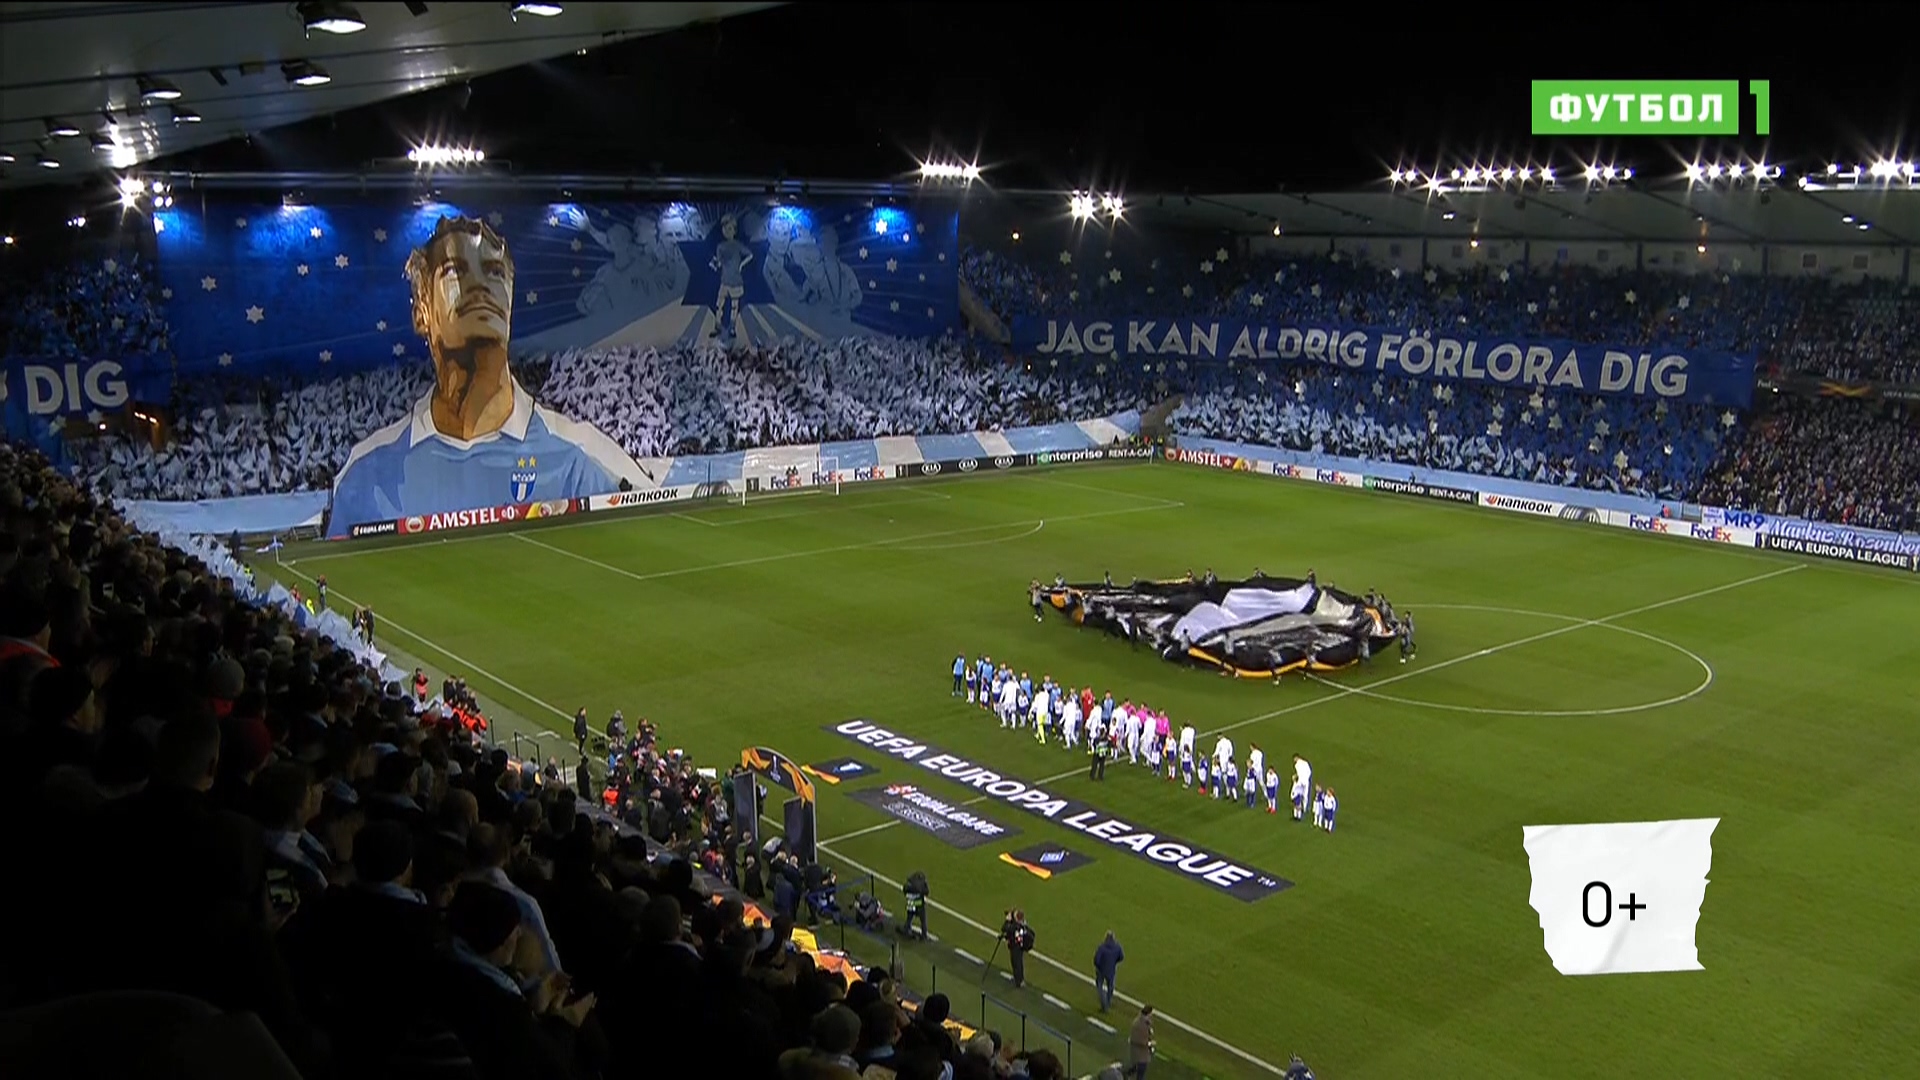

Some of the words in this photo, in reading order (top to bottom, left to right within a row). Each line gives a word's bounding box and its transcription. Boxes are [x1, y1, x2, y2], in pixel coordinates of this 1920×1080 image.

[1036, 320, 1115, 354] JAG
[1127, 321, 1220, 357] KAN
[1228, 325, 1368, 367] ALDRIG
[1375, 328, 1584, 389] FÖRLORA
[1599, 351, 1689, 396] DIG
[24, 360, 129, 414] DIG
[1040, 448, 1104, 463] enterprise
[1178, 450, 1223, 468] AMSTEL
[854, 465, 886, 481] FedEx
[1272, 462, 1301, 478] FedEx
[1316, 468, 1348, 485] FedEx
[1364, 475, 1425, 495] enterprise
[1428, 487, 1472, 502] RENT-A-CAR
[429, 506, 500, 531] AMSTEL
[1628, 514, 1668, 533] FedEx
[1724, 510, 1765, 530] MR9
[1690, 523, 1732, 543] FedEx
[1770, 519, 1835, 544] Markus
[1771, 536, 1804, 552] UEFA
[1805, 541, 1856, 560] EUROPA
[1857, 549, 1908, 568] LEAGUE
[836, 720, 927, 760] UEFA
[919, 753, 1068, 817] EUROPA
[1062, 811, 1254, 887] LEAGUE
